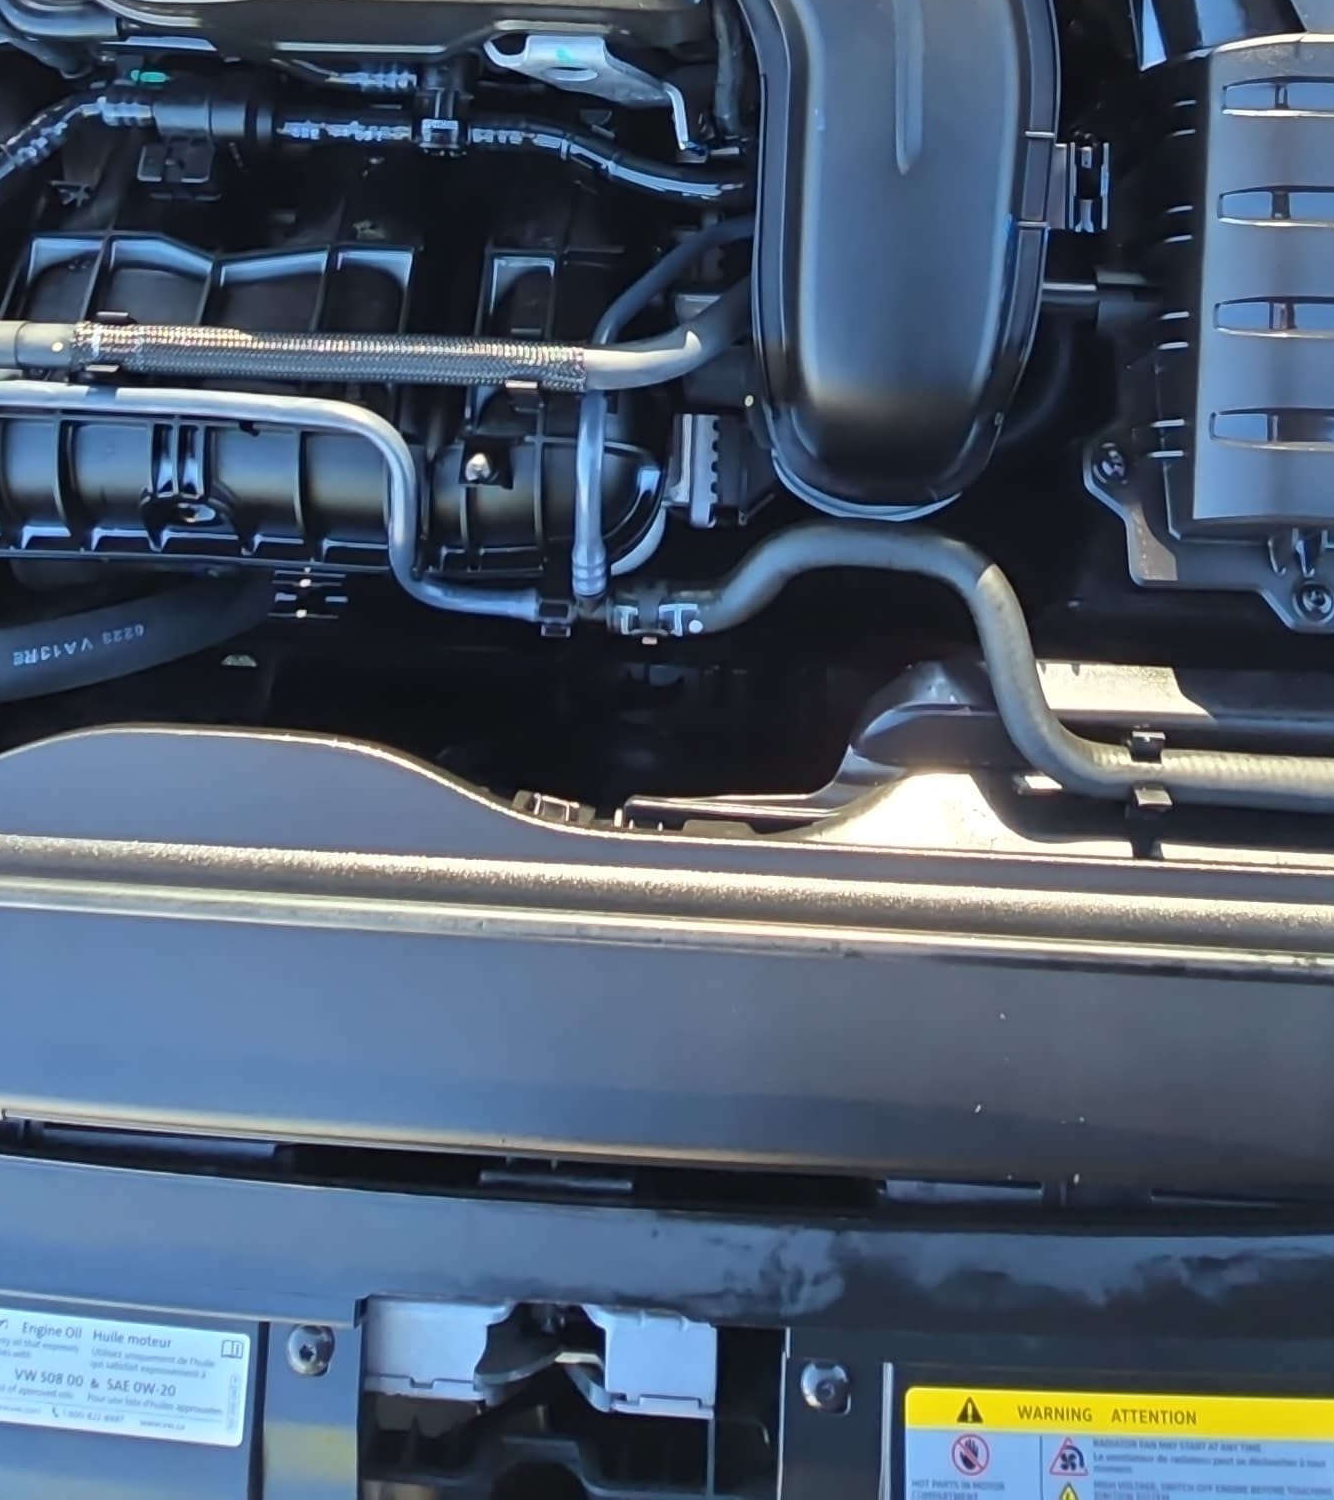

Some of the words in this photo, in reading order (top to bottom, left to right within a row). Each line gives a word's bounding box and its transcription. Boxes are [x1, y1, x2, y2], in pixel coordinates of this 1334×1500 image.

[21, 1322, 62, 1339] Engine
[64, 1326, 82, 1339] Oil
[92, 1330, 124, 1344] Huile
[127, 1334, 171, 1349] moteur
[14, 1368, 36, 1381] VW
[40, 1371, 63, 1384] 508
[66, 1374, 83, 1386] 00
[90, 1378, 99, 1387] &
[106, 1378, 130, 1391] SAE
[133, 1381, 176, 1396] 0W-20
[1017, 1404, 1093, 1423] WARNING
[1110, 1408, 1198, 1426] ATTENTION
